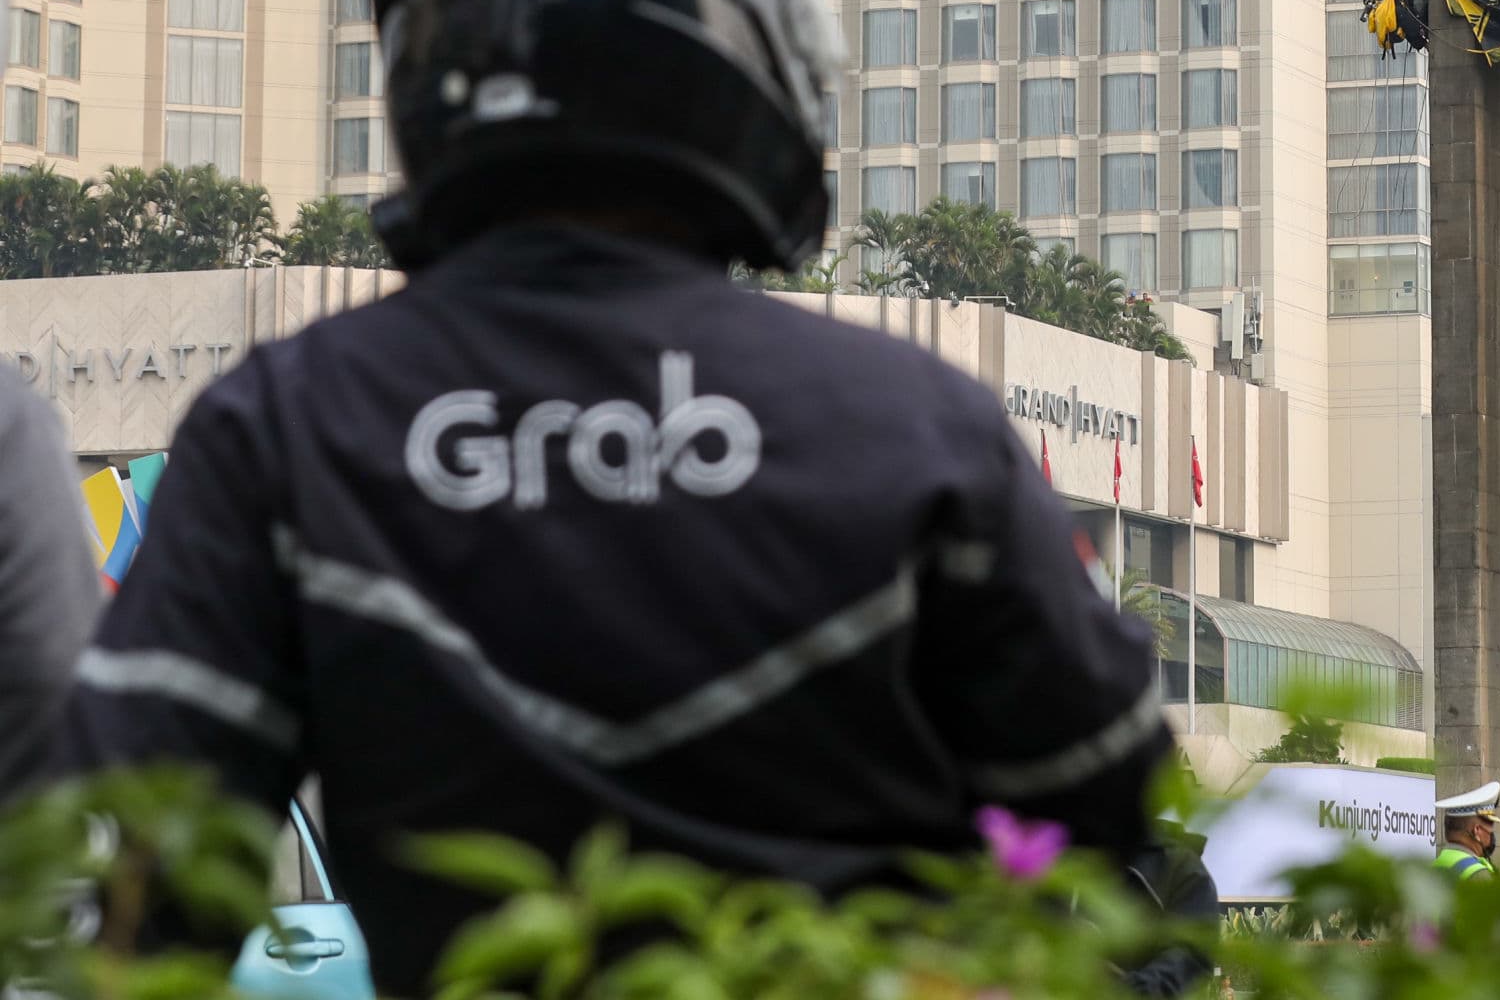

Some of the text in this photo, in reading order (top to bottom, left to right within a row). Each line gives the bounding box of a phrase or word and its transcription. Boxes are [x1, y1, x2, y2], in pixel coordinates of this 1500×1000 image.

[68, 344, 232, 384] HYATT
[405, 350, 763, 511] Grab
[1004, 382, 1139, 445] GRAND HYATT
[1319, 800, 1381, 841] Kunjungi
[1384, 805, 1437, 846] Samsung
